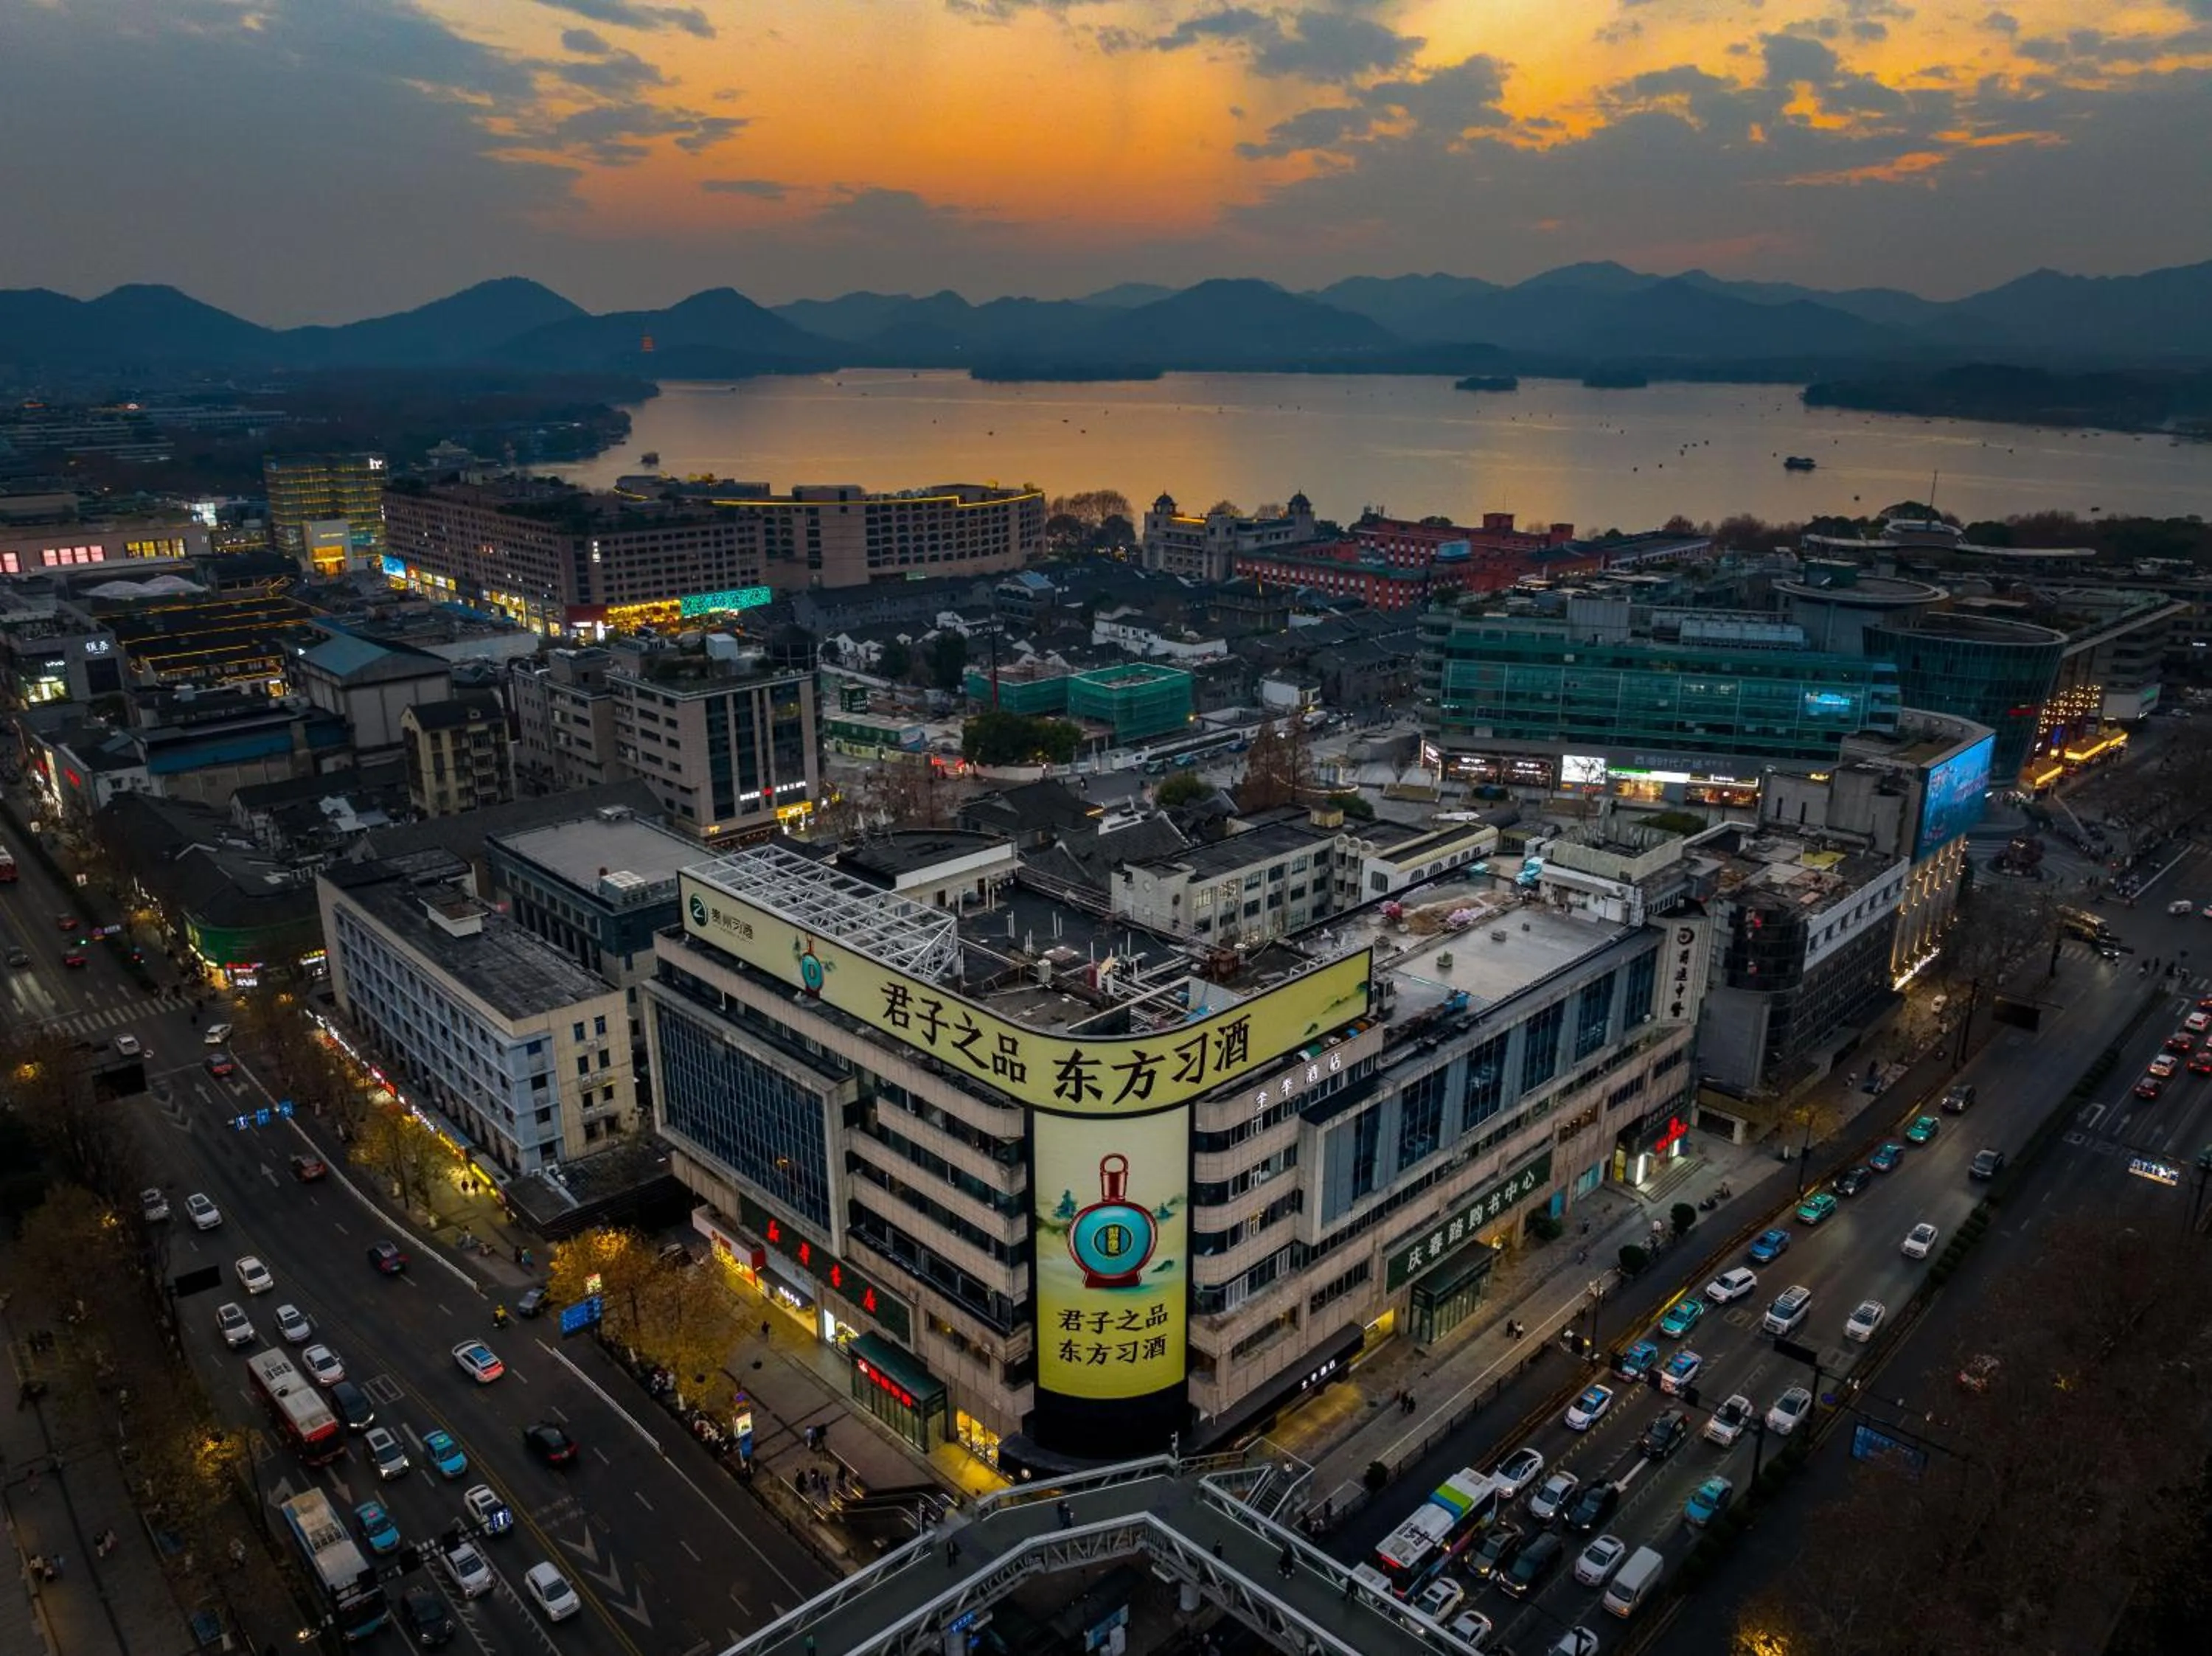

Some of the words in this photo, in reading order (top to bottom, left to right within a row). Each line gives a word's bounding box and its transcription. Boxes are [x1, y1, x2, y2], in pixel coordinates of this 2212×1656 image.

[880, 981, 1027, 1085] 君子之品
[1053, 1014, 1252, 1104] 东方习酒
[1256, 1052, 1341, 1112] 全季酒店
[1407, 1169, 1535, 1274] 庆春路购书中心
[1057, 1303, 1169, 1335] 君子之品
[1058, 1333, 1166, 1366] 东方习酒
